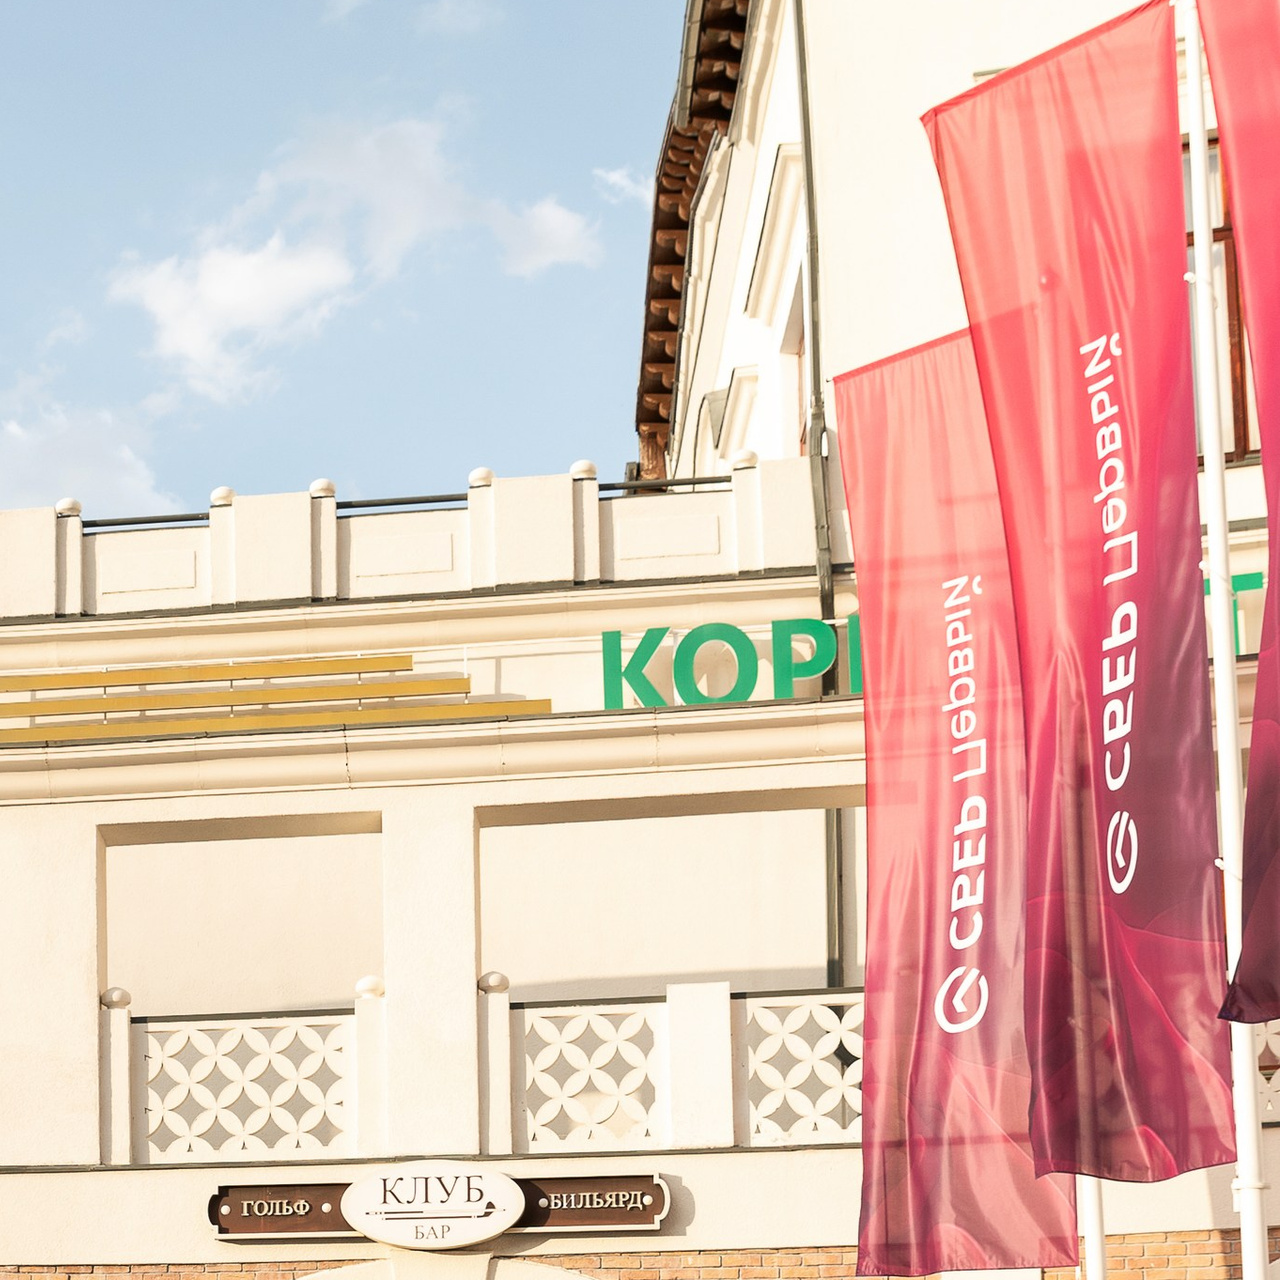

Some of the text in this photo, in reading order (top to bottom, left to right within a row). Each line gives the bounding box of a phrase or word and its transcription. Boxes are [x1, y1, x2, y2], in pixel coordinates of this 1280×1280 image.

[602, 614, 863, 710] КОР
[380, 1175, 484, 1205] КЛУБ
[548, 1190, 644, 1212] БИЛЬЯРД
[240, 1199, 311, 1217] ГОЛЬФ
[415, 1225, 451, 1240] БАР
